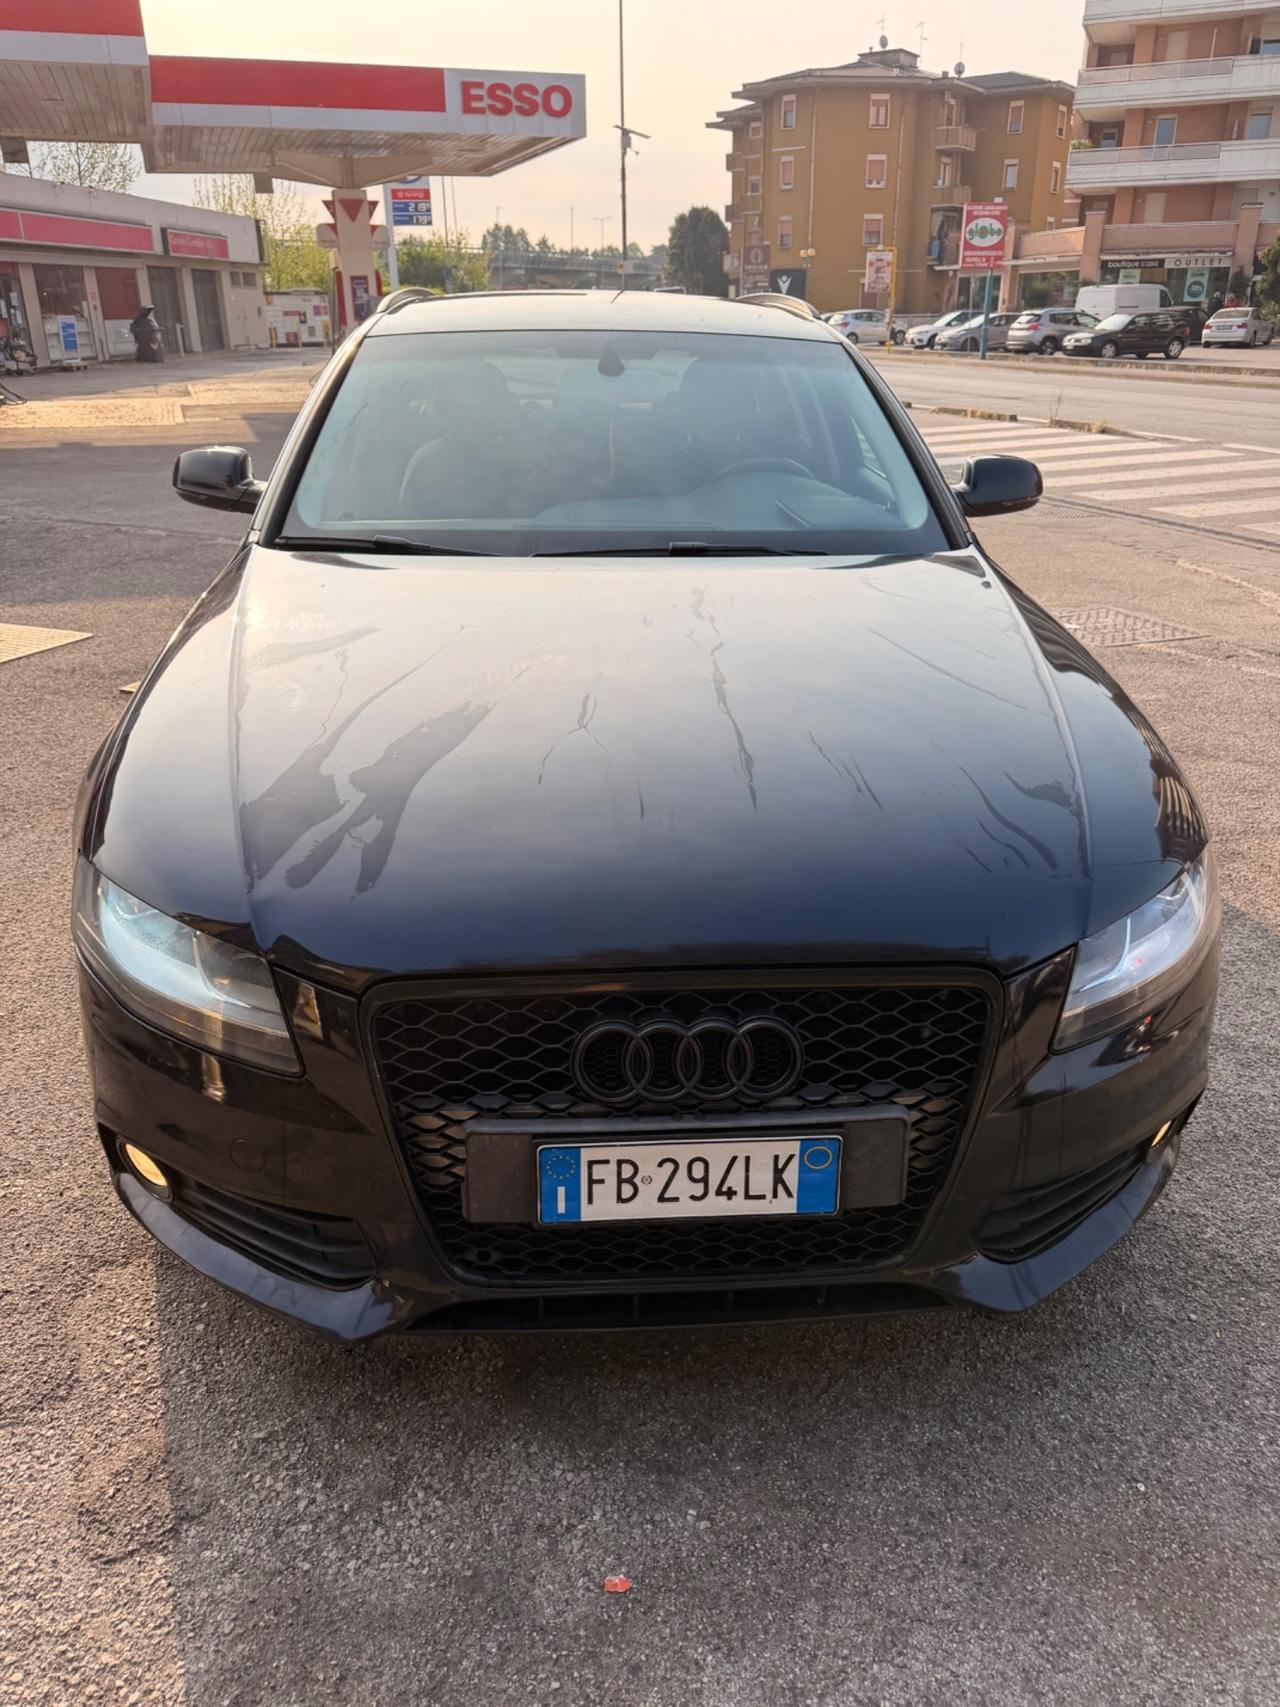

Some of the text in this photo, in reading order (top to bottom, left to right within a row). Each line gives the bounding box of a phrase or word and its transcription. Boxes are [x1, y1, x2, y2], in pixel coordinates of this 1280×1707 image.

[460, 80, 573, 118] ESSO
[1107, 261, 1139, 269] boutique
[1174, 258, 1223, 267] OUTLET
